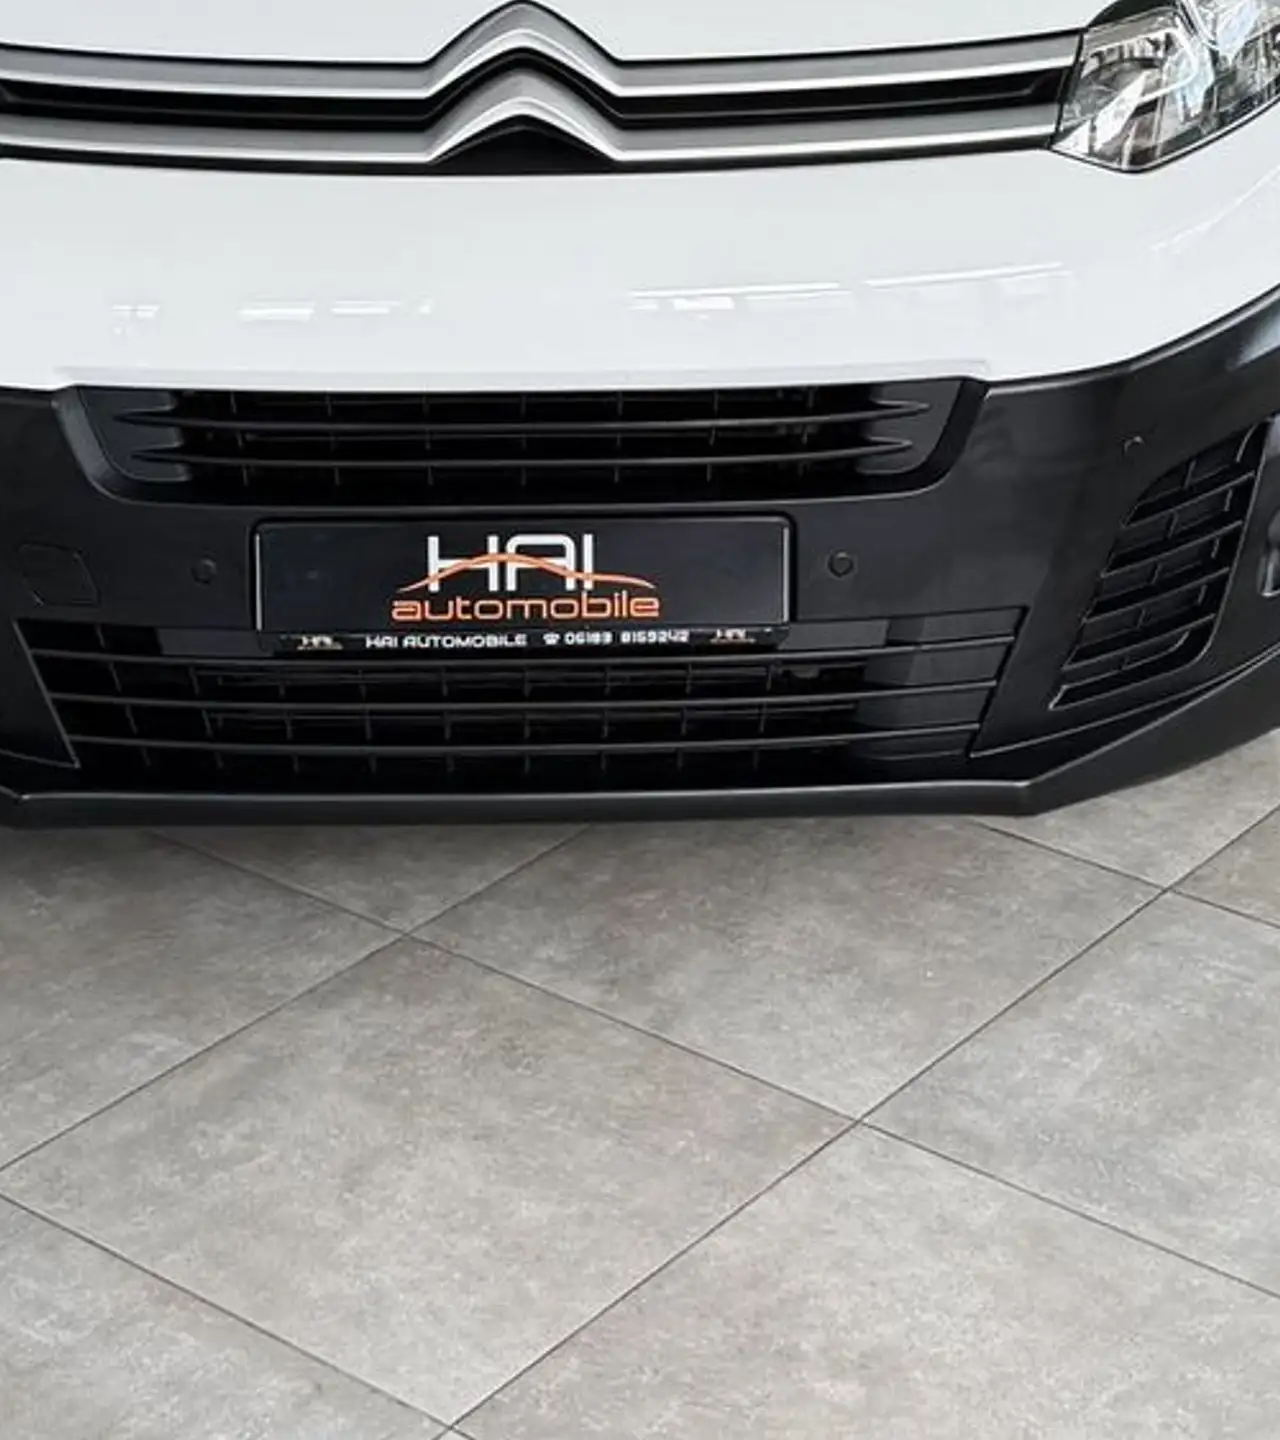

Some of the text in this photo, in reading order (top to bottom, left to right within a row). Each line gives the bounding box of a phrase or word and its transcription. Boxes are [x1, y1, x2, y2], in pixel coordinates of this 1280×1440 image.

[426, 533, 595, 592] HAI
[391, 591, 660, 622] automobile
[365, 634, 398, 648] HAI
[403, 633, 527, 648] AUTOMOBILE
